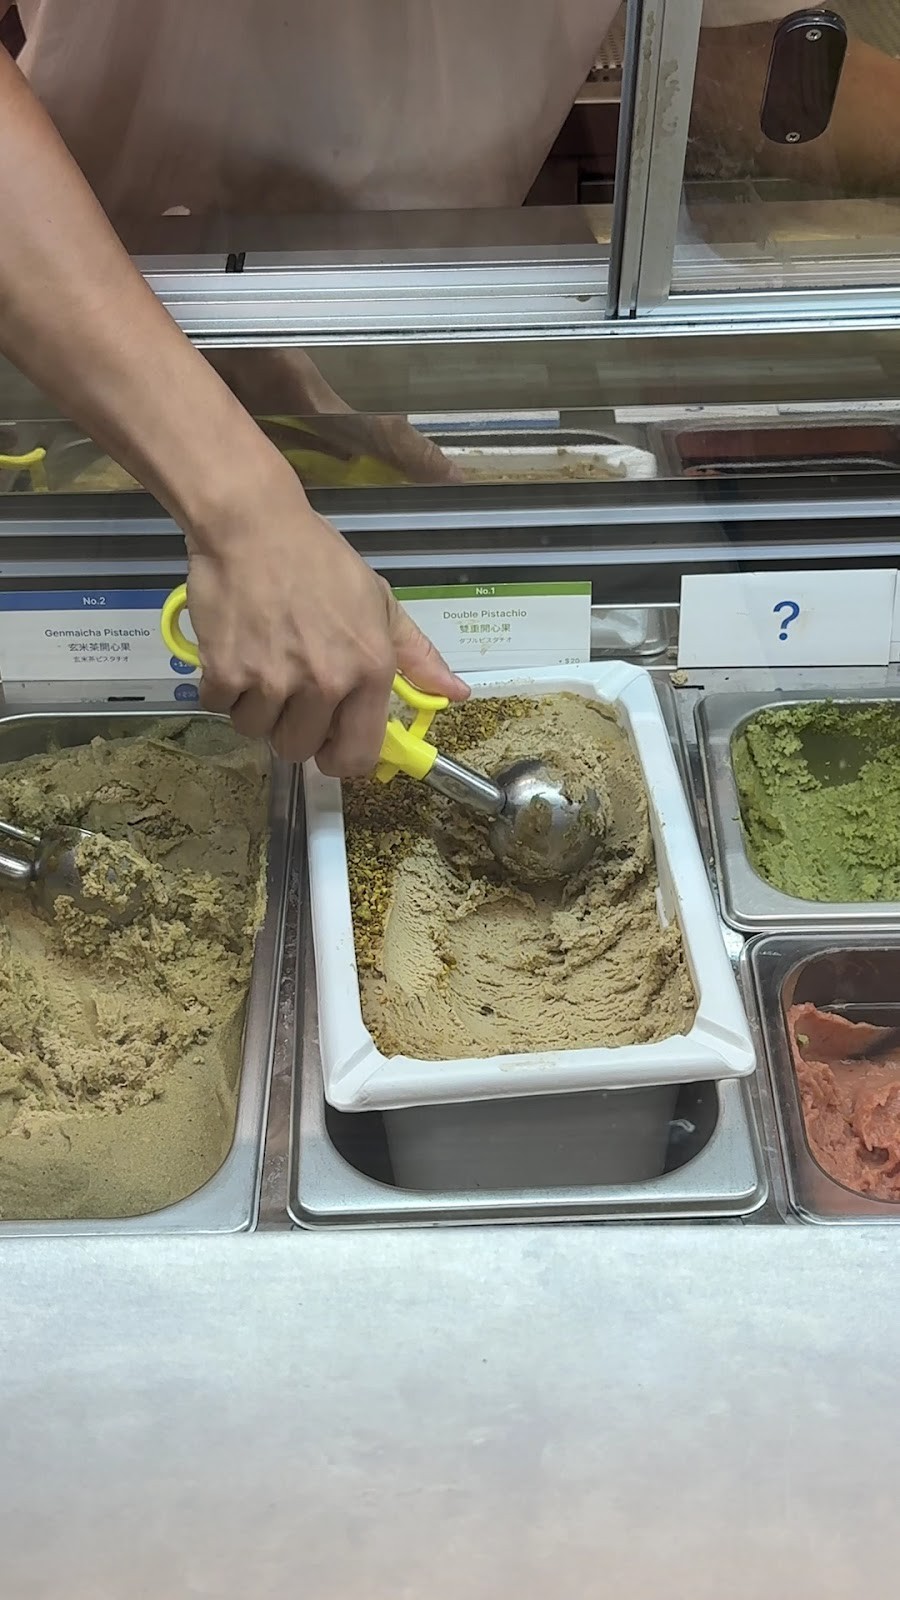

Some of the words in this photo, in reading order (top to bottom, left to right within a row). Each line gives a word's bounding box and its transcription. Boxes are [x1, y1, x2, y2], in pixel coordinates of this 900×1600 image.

[475, 587, 496, 595] No.1
[82, 596, 106, 606] No.2
[443, 610, 479, 619] Double
[481, 609, 527, 619] Pistachio
[772, 600, 801, 641] ?
[44, 628, 102, 638] Genmaicha
[104, 627, 151, 637] Pistachio
[459, 623, 511, 633] 雙重開心果
[68, 642, 131, 652] 玄米茶開心果
